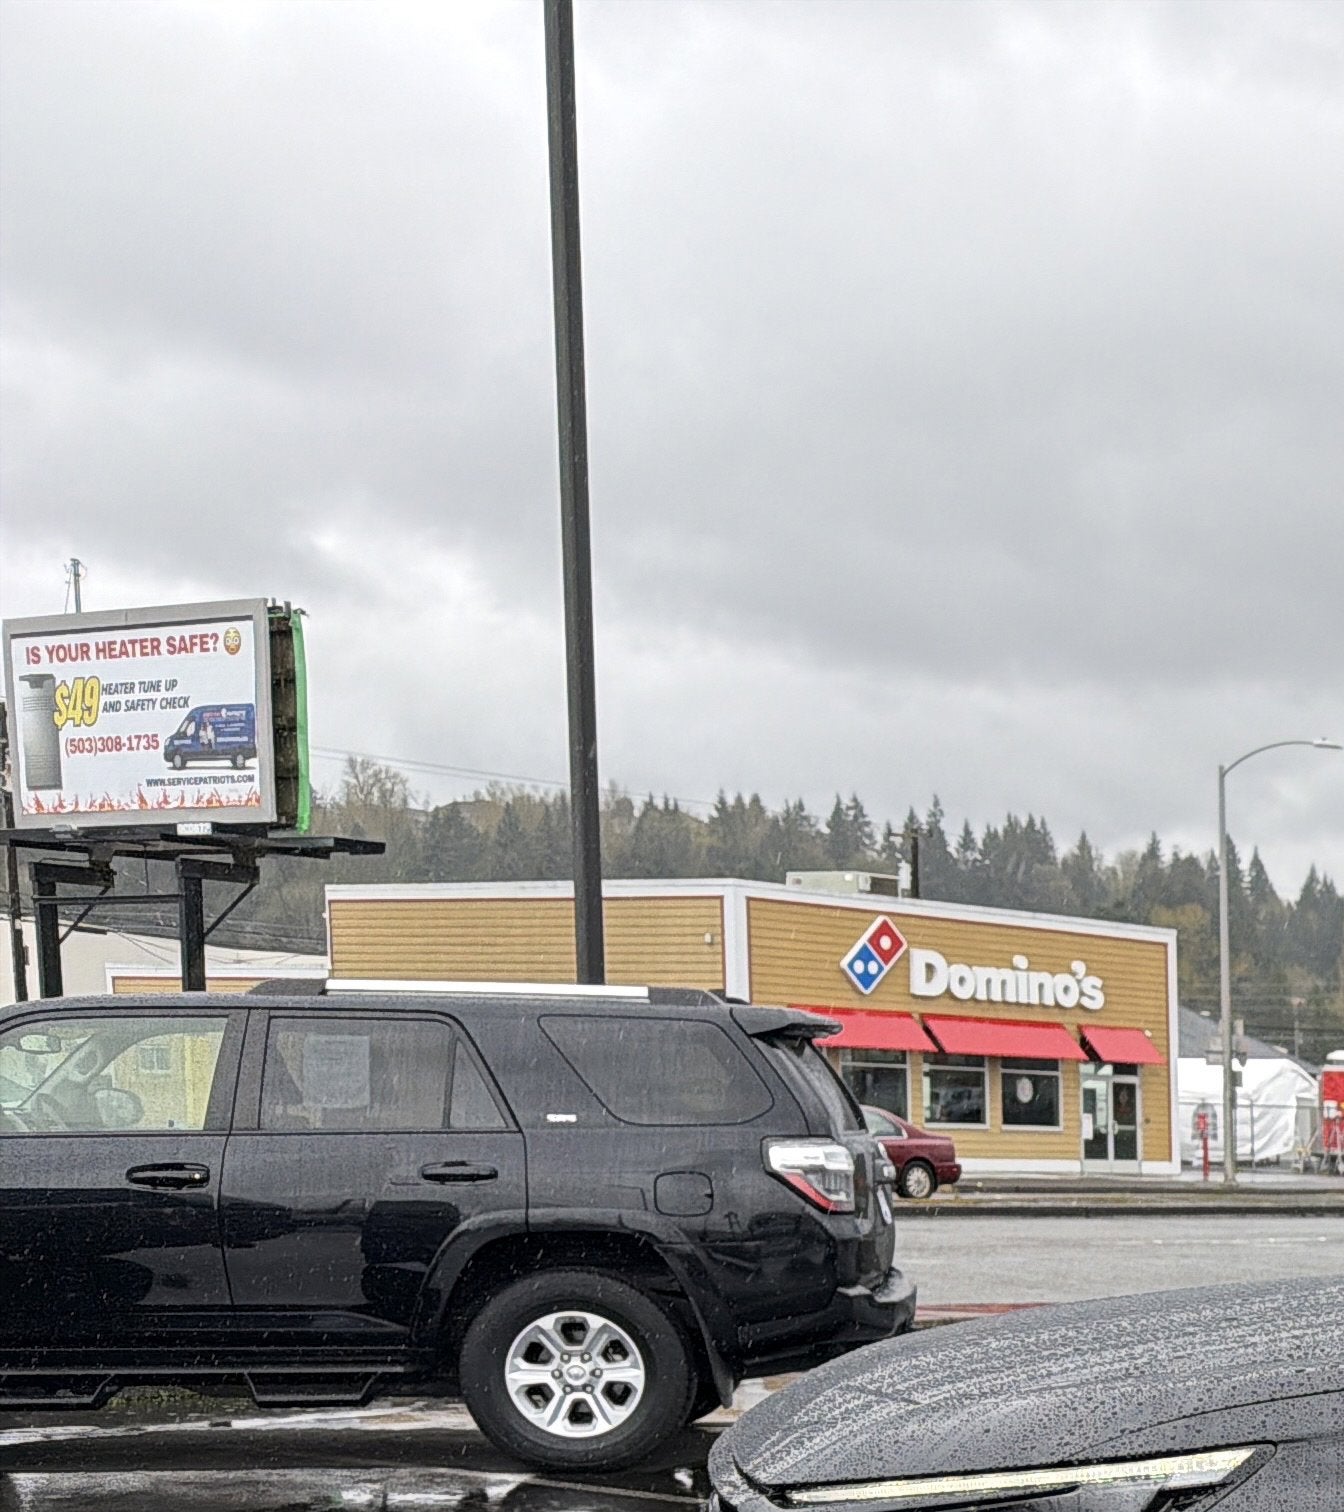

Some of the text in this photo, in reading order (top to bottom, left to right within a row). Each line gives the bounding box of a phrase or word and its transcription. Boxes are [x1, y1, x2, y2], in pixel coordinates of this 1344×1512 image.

[25, 632, 220, 665] IS YOUR HEATER SAFE?
[101, 678, 178, 696] HEATER TUNE UP
[53, 675, 100, 731] $49
[101, 696, 191, 713] AND SAFETY CHECK
[65, 733, 160, 758] (503)308-1735
[145, 774, 255, 788] WWW.SERVICEPATRIOTS.COM
[909, 948, 1105, 1011] Domino's
